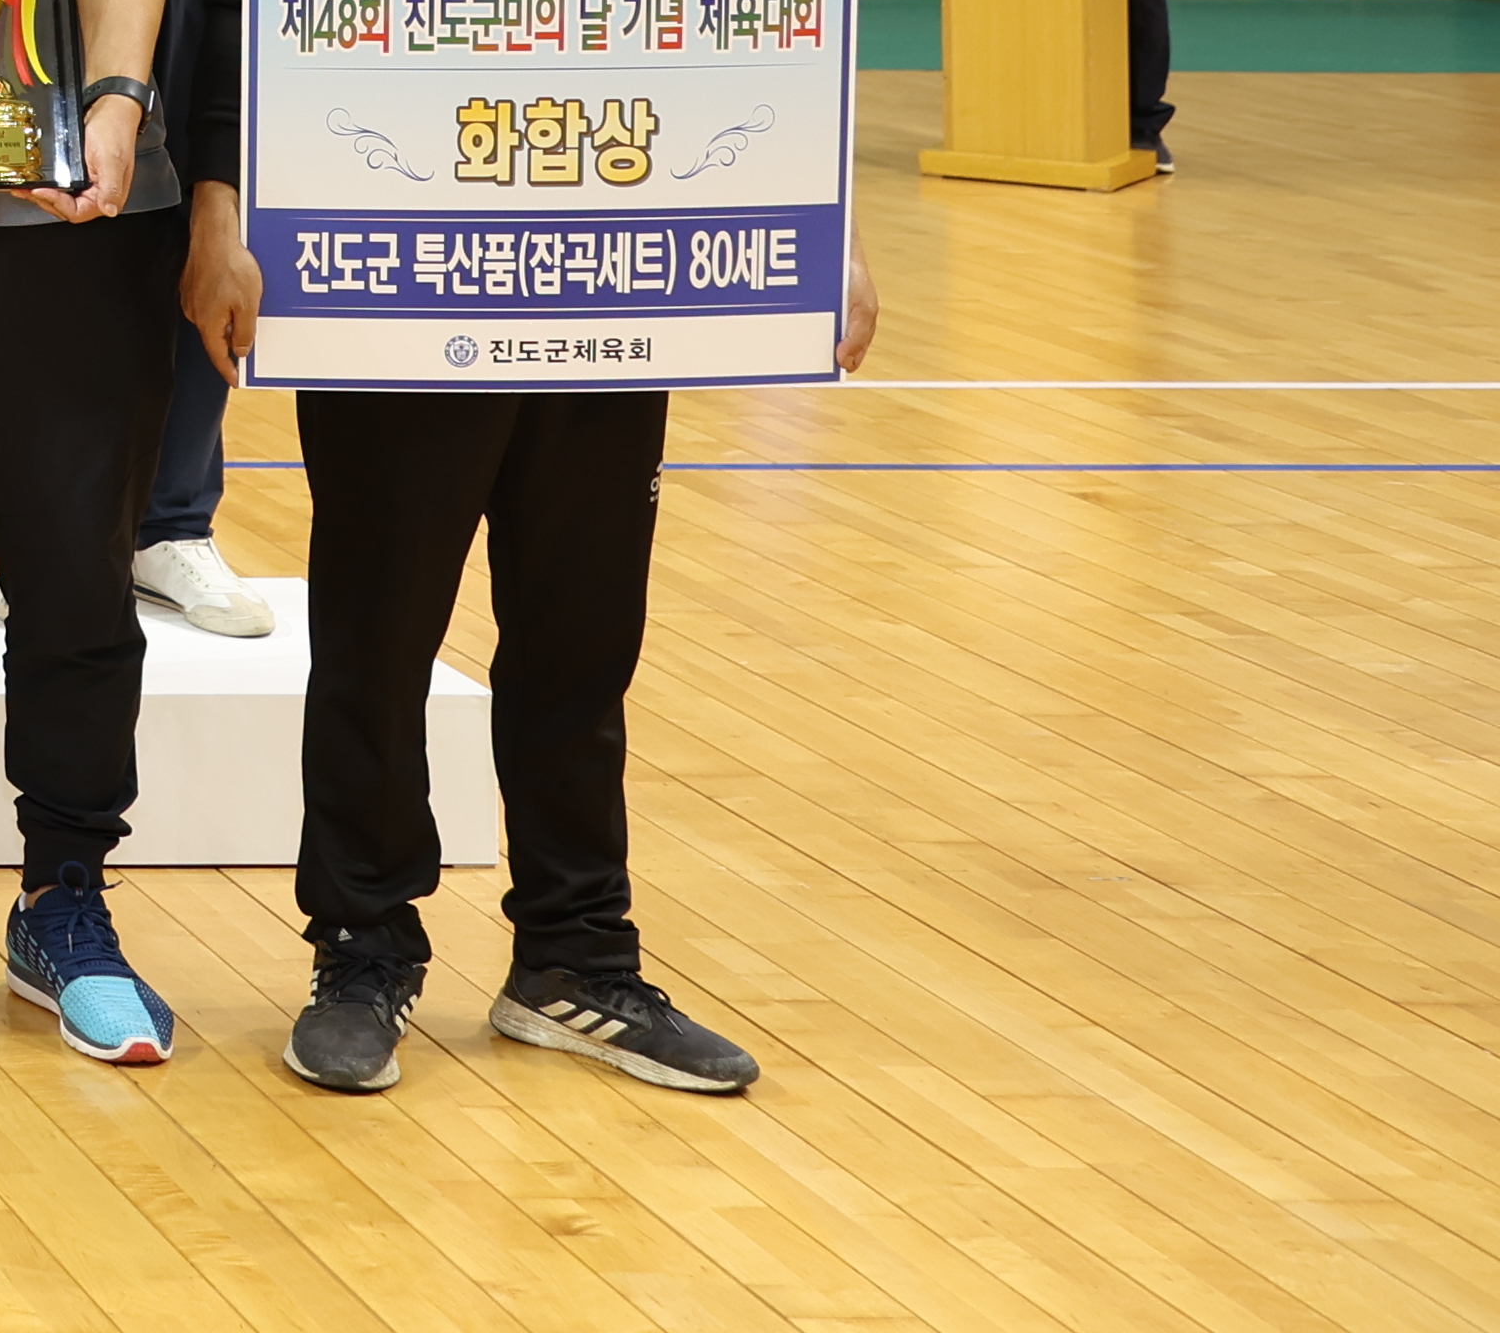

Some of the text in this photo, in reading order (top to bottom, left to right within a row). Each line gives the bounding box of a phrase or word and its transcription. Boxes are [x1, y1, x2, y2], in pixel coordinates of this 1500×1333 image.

[455, 97, 658, 186] 화합상
[295, 228, 799, 297] 진도군 특산품(잡곡세트) 80세트
[489, 339, 653, 363] 진도군체육회
